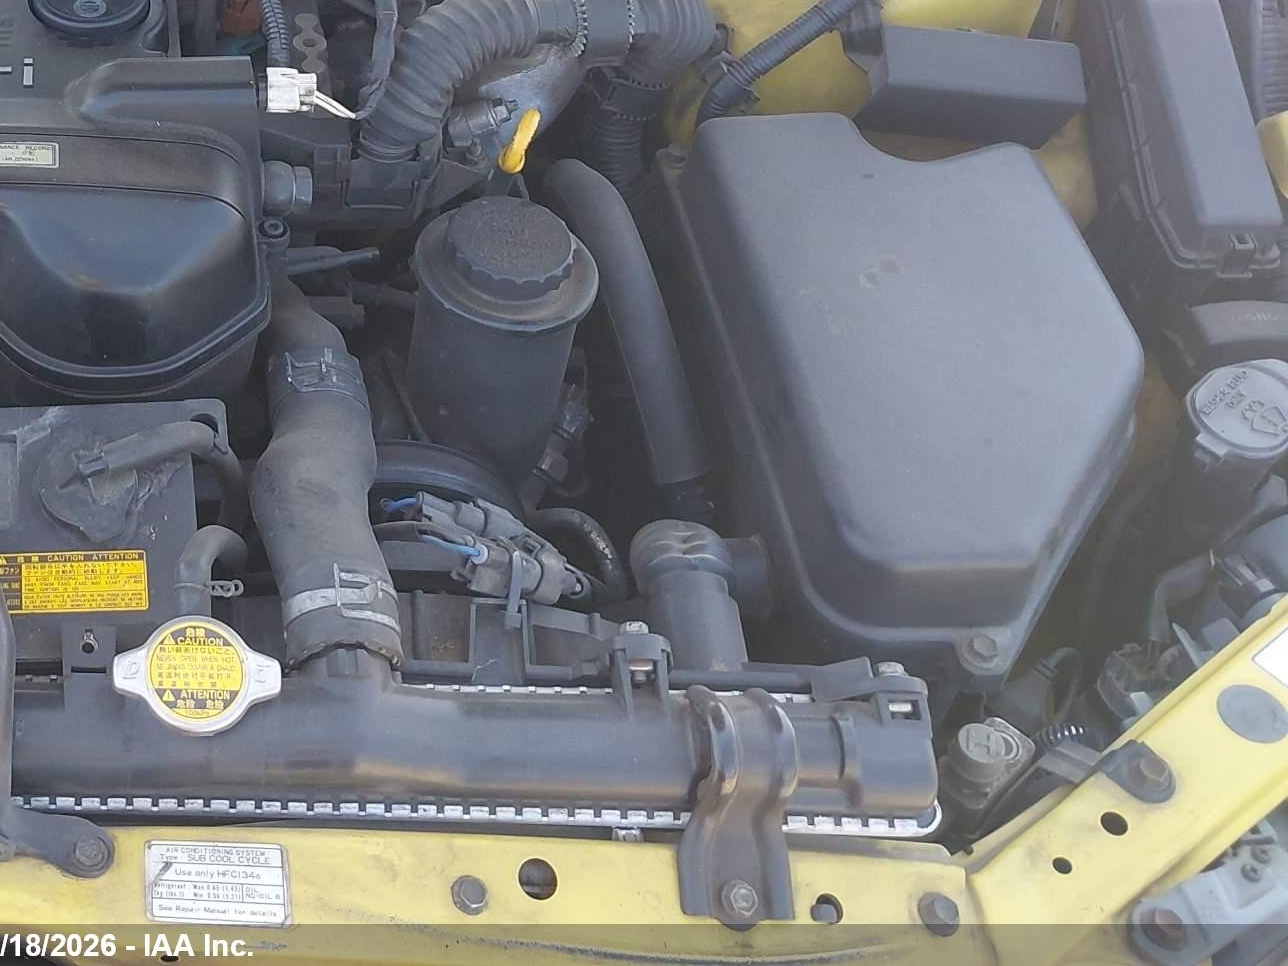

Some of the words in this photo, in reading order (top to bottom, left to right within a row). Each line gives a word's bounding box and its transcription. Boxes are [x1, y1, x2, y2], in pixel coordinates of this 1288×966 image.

[177, 638, 224, 646] CAUTION
[180, 690, 230, 700] ATTENTION
[181, 847, 234, 856] CONDITIONING
[187, 854, 206, 862] SUB
[209, 854, 236, 863] COOL
[238, 856, 271, 865] CYCLE
[195, 869, 215, 879] only
[175, 905, 201, 913] Repair
